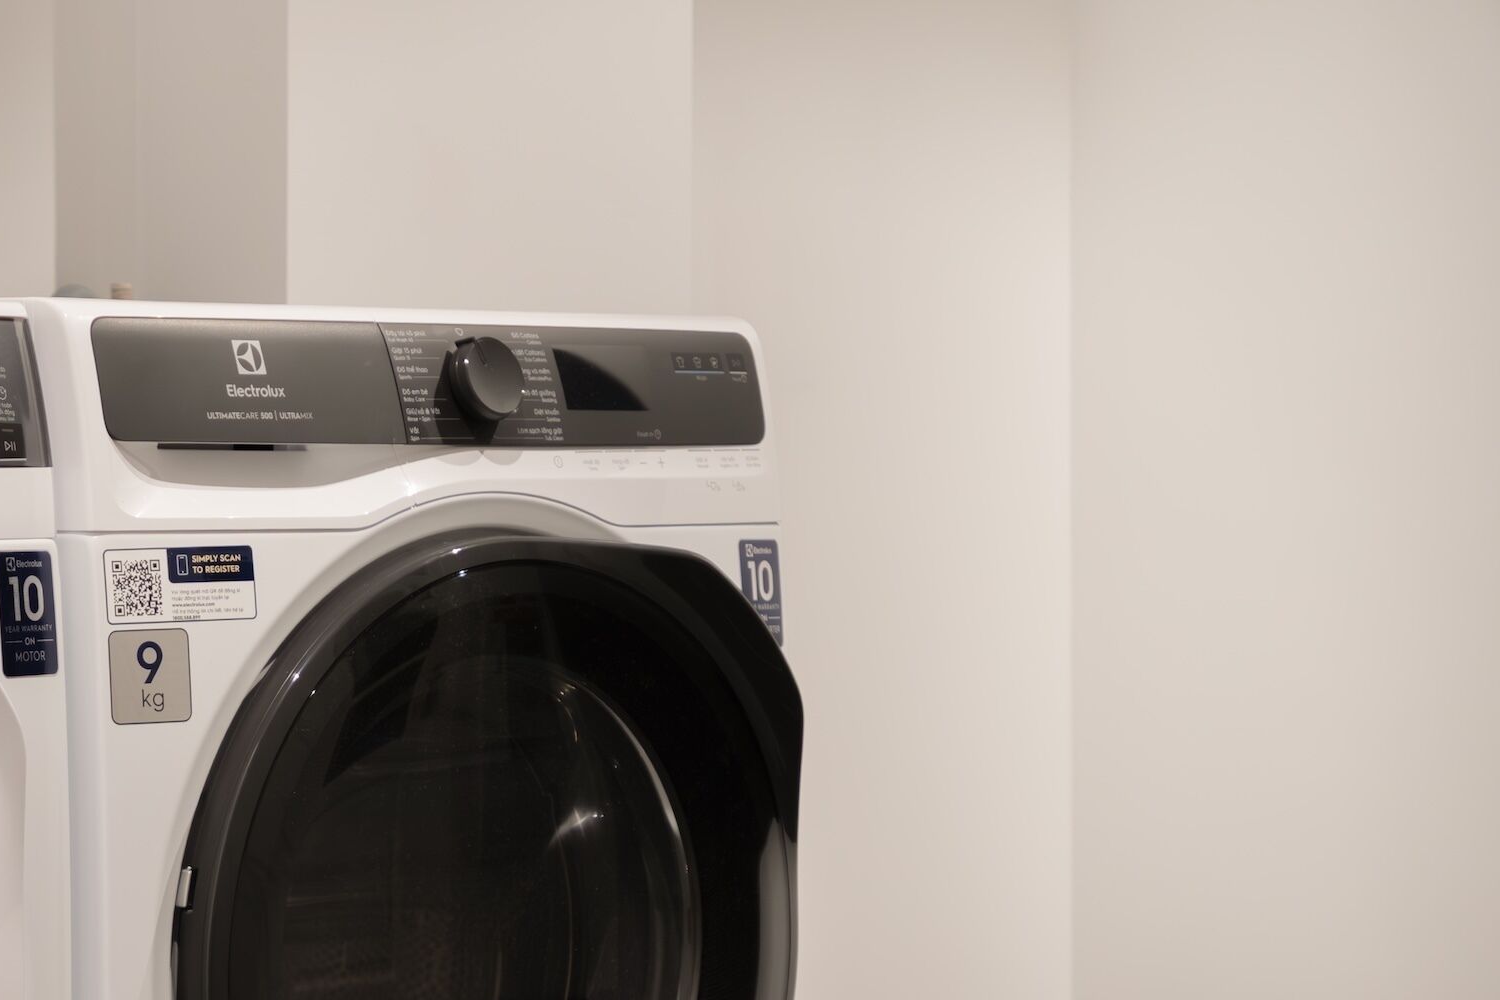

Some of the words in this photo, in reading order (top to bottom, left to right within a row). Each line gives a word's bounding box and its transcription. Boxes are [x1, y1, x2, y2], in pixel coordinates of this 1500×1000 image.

[225, 384, 286, 398] Electrolux
[206, 411, 259, 420] ULTIMATECARE
[192, 554, 218, 563] SIMPLY
[220, 554, 241, 562] SCAN
[16, 560, 42, 568] Electrolux
[192, 566, 203, 574] TO
[205, 565, 240, 573] REGISTER
[747, 560, 774, 601] 10
[8, 575, 45, 622] 10
[21, 624, 52, 632] WARRANTY
[24, 637, 35, 646] ON
[15, 650, 46, 662] MOTOR
[136, 641, 163, 684] 9
[142, 689, 164, 712] kg
